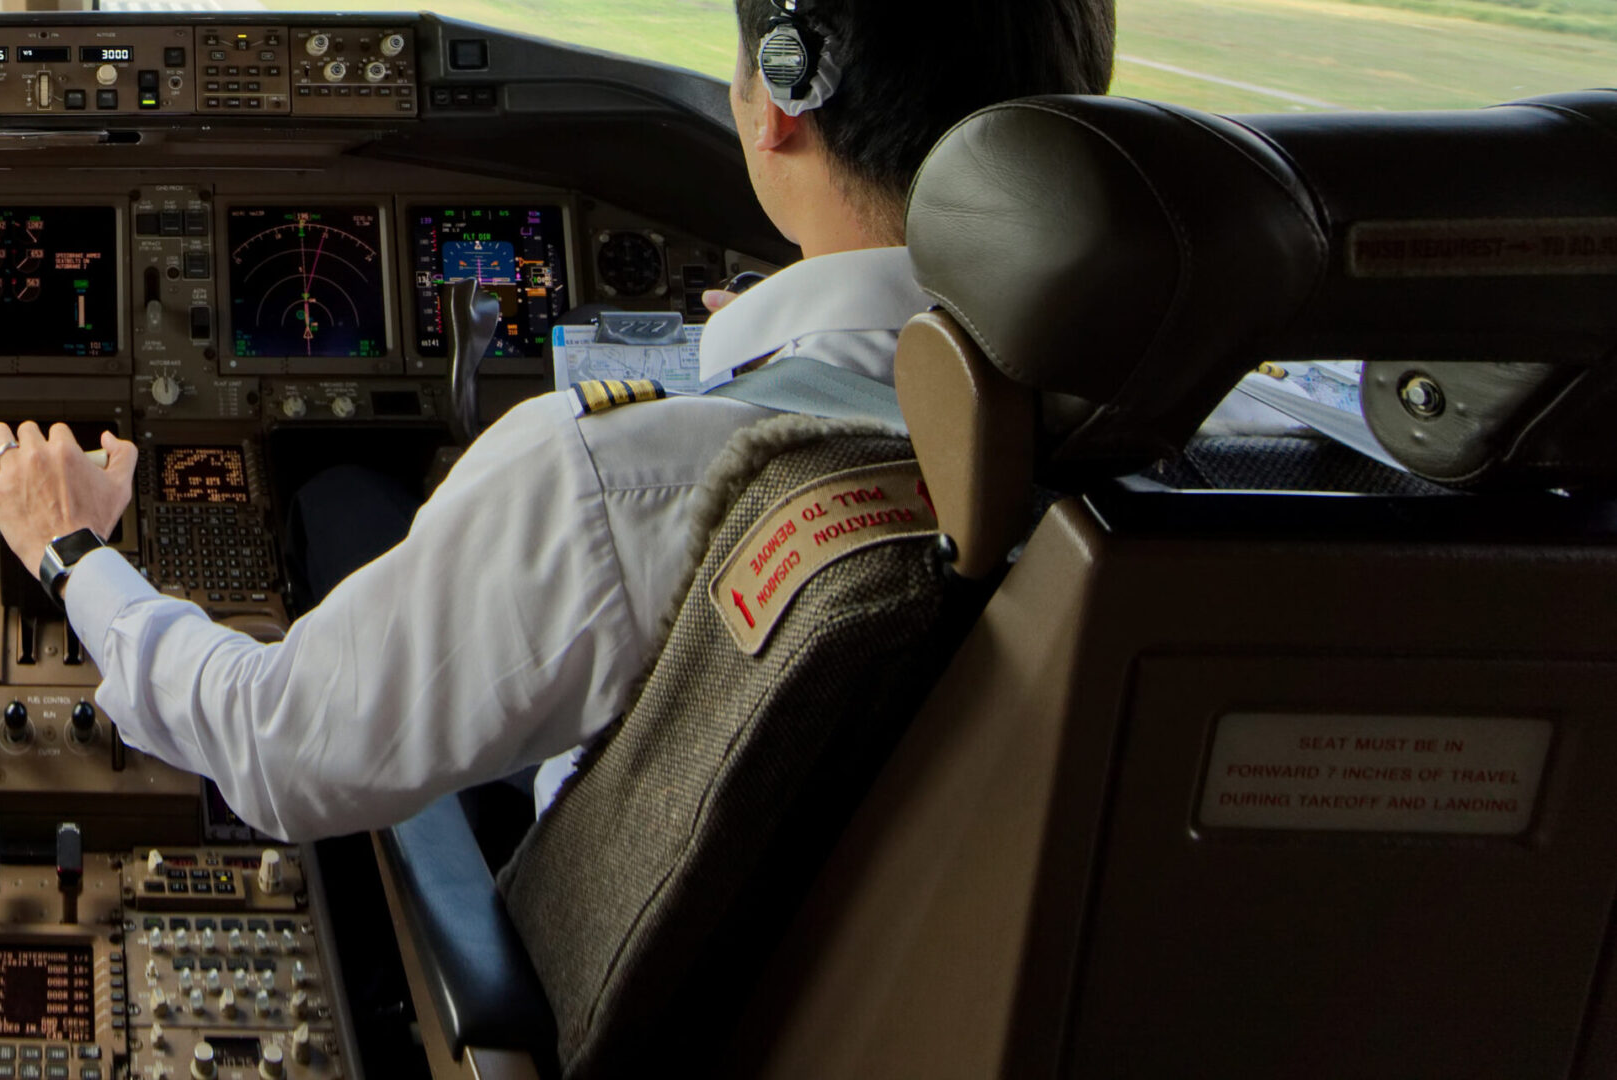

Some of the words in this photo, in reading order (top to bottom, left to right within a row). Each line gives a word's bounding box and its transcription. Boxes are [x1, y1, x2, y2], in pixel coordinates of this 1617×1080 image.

[101, 49, 129, 60] 3000
[619, 320, 667, 332] 777
[832, 486, 884, 508] PULL
[801, 502, 828, 522] TO
[813, 508, 913, 546] FLOTATION
[749, 520, 797, 576] REMOVE
[756, 550, 801, 608] CUSHION
[28, 697, 40, 705] FUEL
[43, 697, 71, 705] CONTROL
[1299, 737, 1346, 750] SEAT
[1354, 738, 1406, 752] MUST
[1414, 738, 1439, 752] BE
[1444, 739, 1464, 752] IN
[1226, 764, 1319, 779] FORWARD
[1327, 766, 1337, 779] 7
[1343, 767, 1411, 781] INCHES
[1418, 768, 1444, 781] OF
[1451, 769, 1520, 784] TRAVEL
[1219, 793, 1290, 807] DURING
[1298, 795, 1380, 809] TAKEOFF
[1387, 796, 1425, 810] AND
[1434, 798, 1517, 812] LANDING
